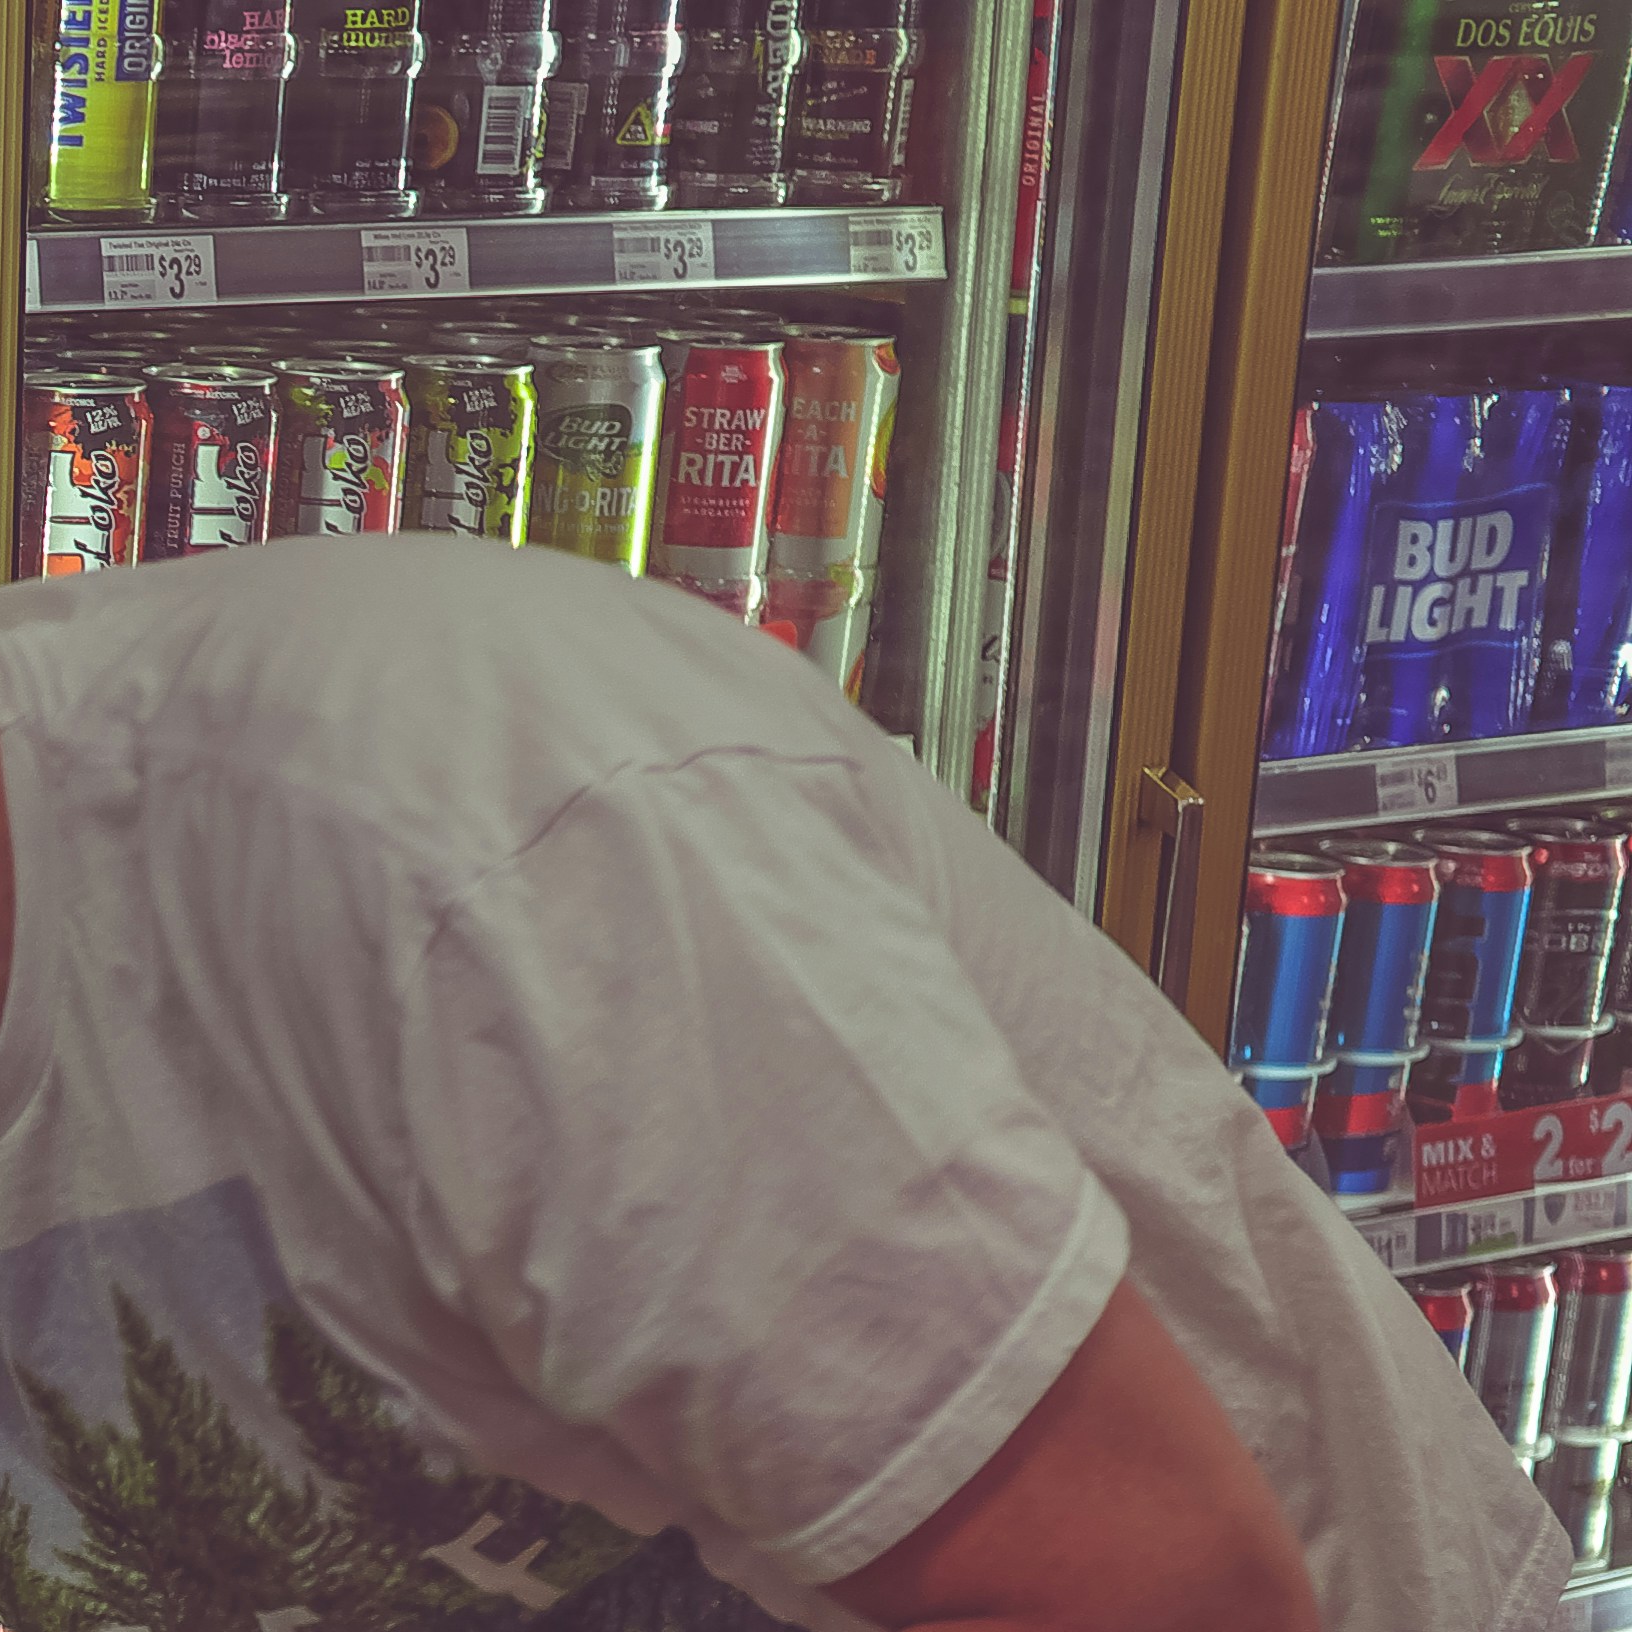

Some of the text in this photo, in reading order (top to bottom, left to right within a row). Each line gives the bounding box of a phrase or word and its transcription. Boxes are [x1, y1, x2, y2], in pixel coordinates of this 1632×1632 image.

[344, 8, 410, 27] HARD
[1456, 14, 1598, 48] DOS EQUIS
[559, 416, 622, 434] BUD
[683, 407, 766, 430] STRAW
[677, 453, 758, 488] RITA
[1394, 509, 1514, 582] BUD
[1366, 570, 1529, 644] LIGHT
[1421, 1133, 1497, 1166] MIX &
[1532, 1114, 1565, 1180] 2
[1420, 1164, 1500, 1197] MATCH
